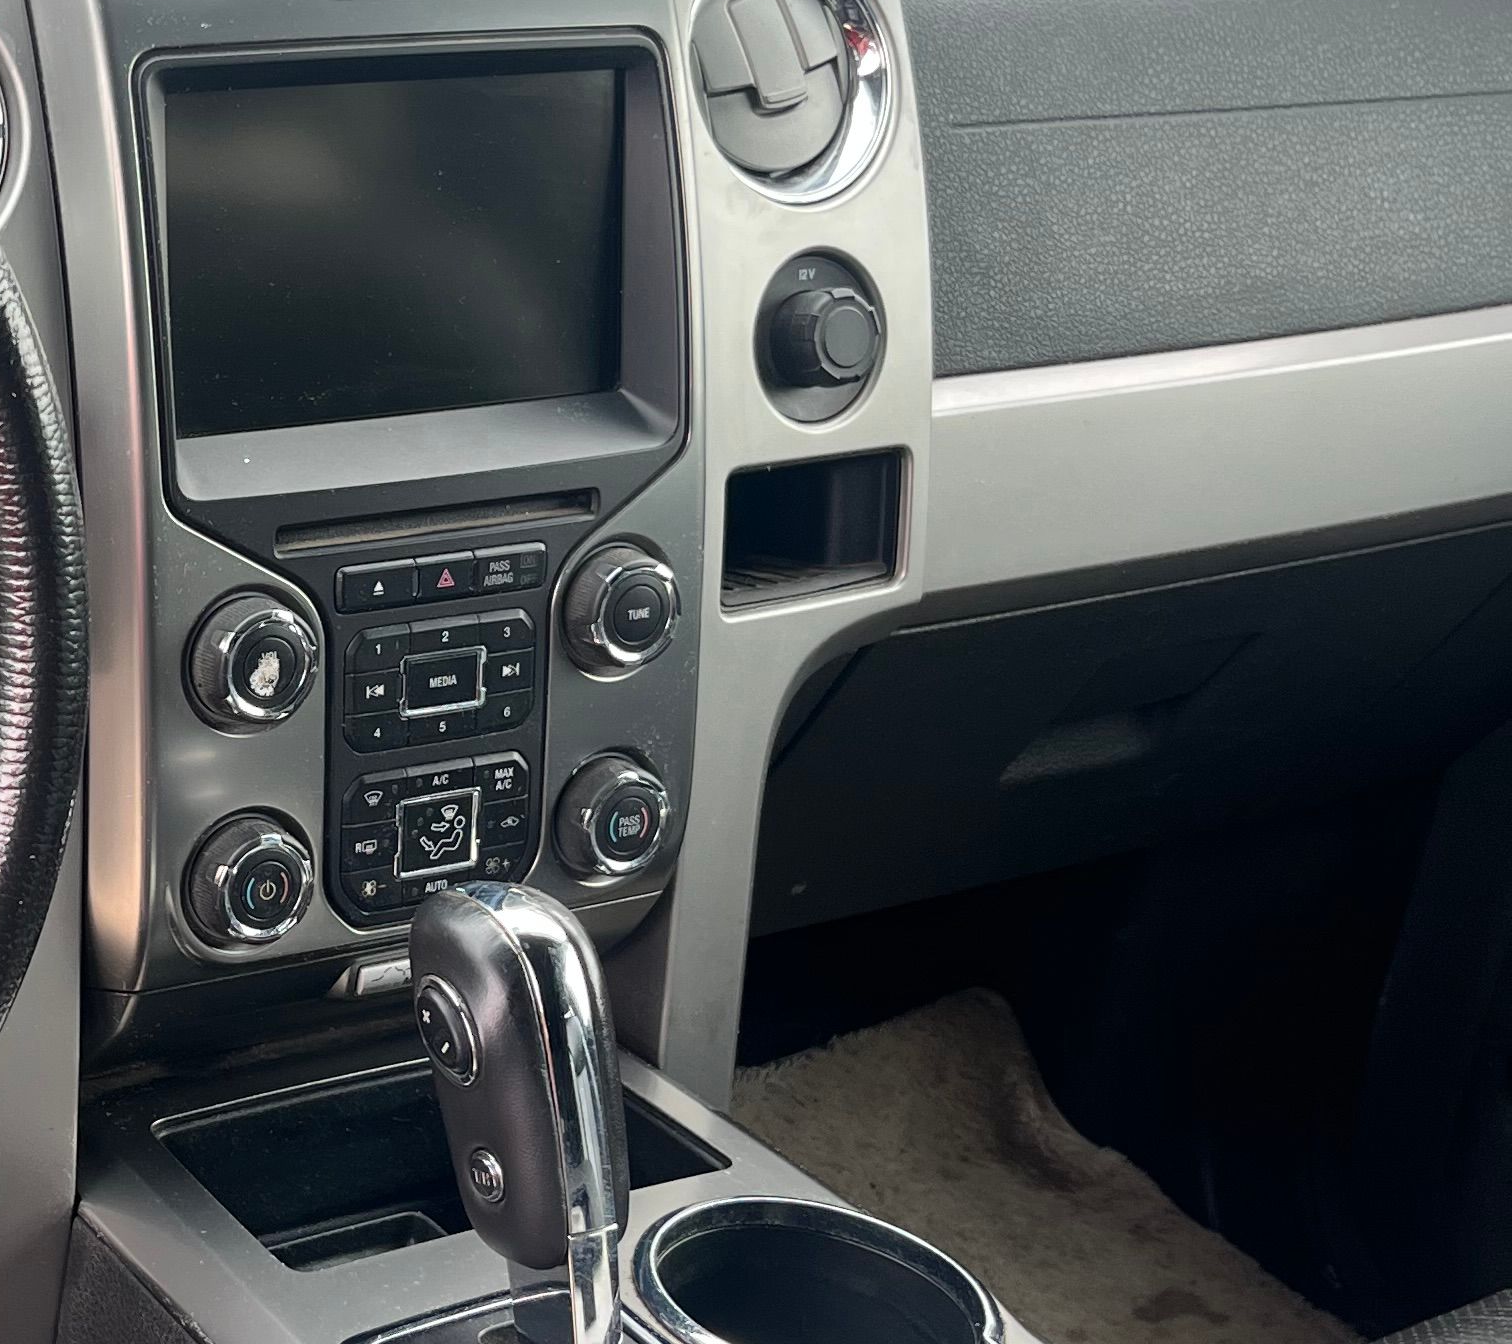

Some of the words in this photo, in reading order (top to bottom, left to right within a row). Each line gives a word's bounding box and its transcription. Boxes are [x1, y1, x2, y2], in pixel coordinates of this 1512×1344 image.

[798, 267, 817, 282] 12V
[489, 560, 511, 573] PASS
[483, 572, 514, 587] AIRBAG
[627, 607, 651, 621] TUNE
[441, 631, 449, 643] 2
[503, 626, 511, 638] 3
[375, 644, 382, 655] 1
[429, 674, 458, 689] MEDIA
[503, 706, 511, 718] 6
[373, 728, 381, 738] 4
[439, 721, 447, 732] 5
[494, 767, 514, 780] MAX
[432, 774, 449, 787] A/C
[495, 779, 513, 791] A/C
[618, 813, 641, 827] PASS
[618, 824, 641, 838] TEMP
[425, 879, 449, 893] AUTO
